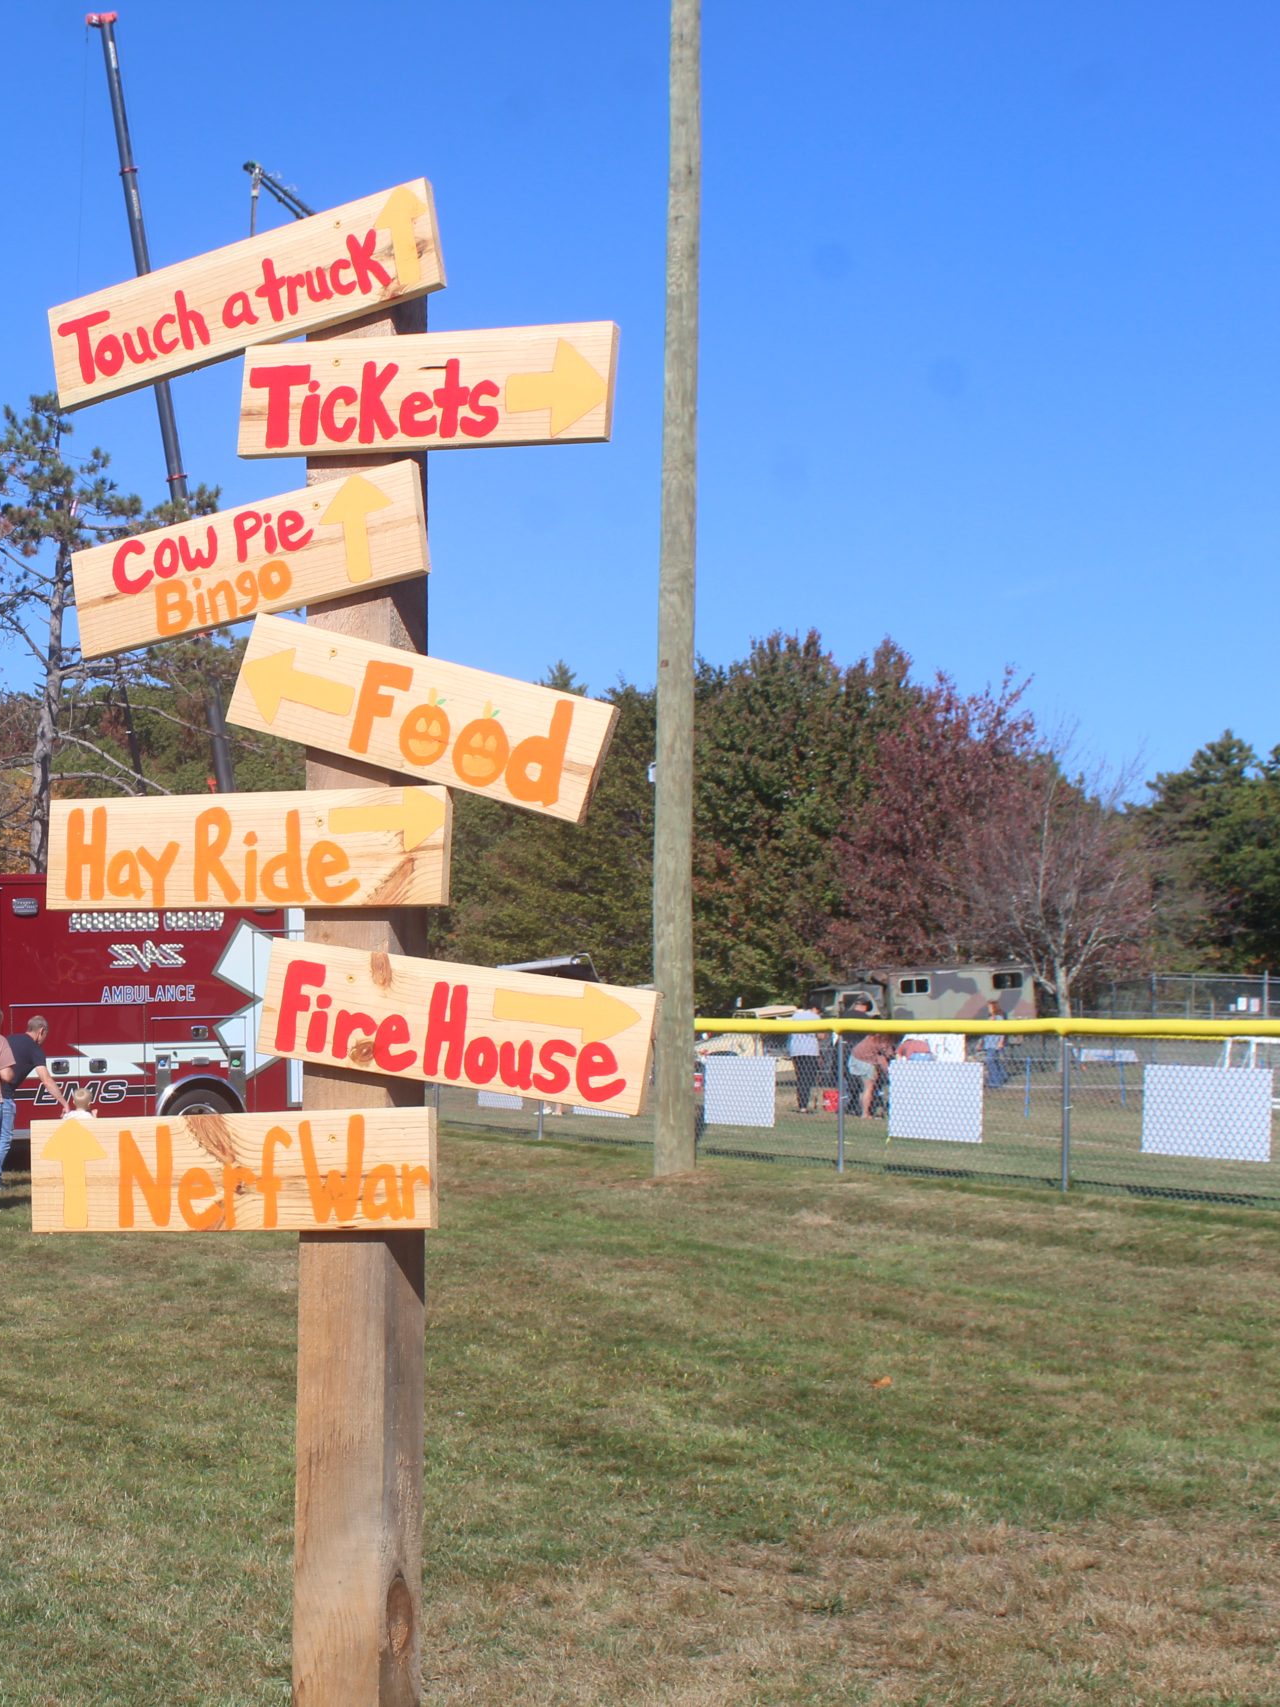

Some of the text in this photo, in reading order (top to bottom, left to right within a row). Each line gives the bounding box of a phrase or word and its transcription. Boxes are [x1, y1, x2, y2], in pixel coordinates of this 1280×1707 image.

[58, 290, 210, 385] Touch
[222, 291, 258, 329] a
[112, 510, 314, 595] Cow Pie
[154, 559, 293, 636] Bingo
[348, 660, 575, 808] Food
[64, 806, 361, 908] Hay Ride
[101, 984, 196, 1004] AMBULANCE
[275, 959, 627, 1103] Fire House
[33, 1079, 128, 1106] EMS
[117, 1113, 432, 1230] Nerf War
